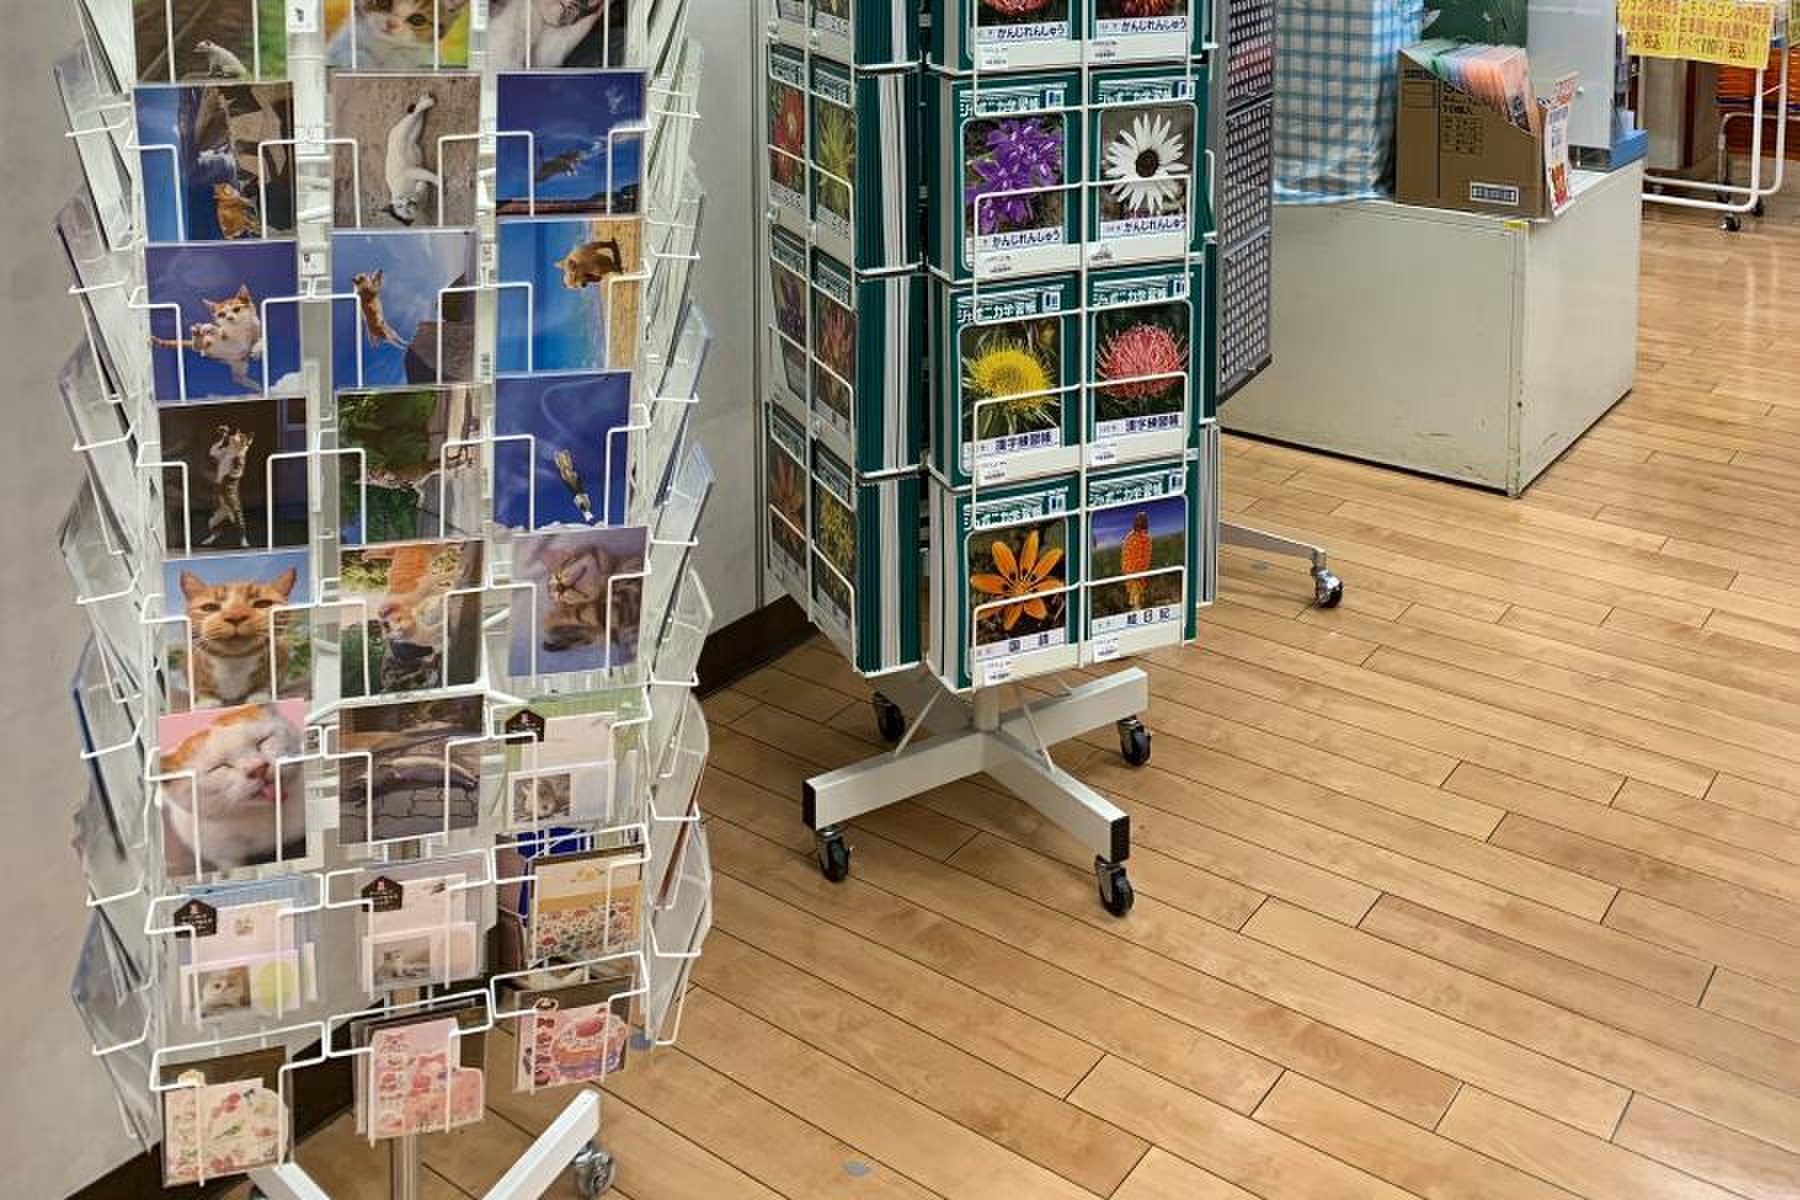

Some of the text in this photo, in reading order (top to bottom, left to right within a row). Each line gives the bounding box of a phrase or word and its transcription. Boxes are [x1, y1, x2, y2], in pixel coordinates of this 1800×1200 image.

[1126, 414, 1180, 432] 漢字練習帳
[995, 431, 1052, 450] 漢字練習帳
